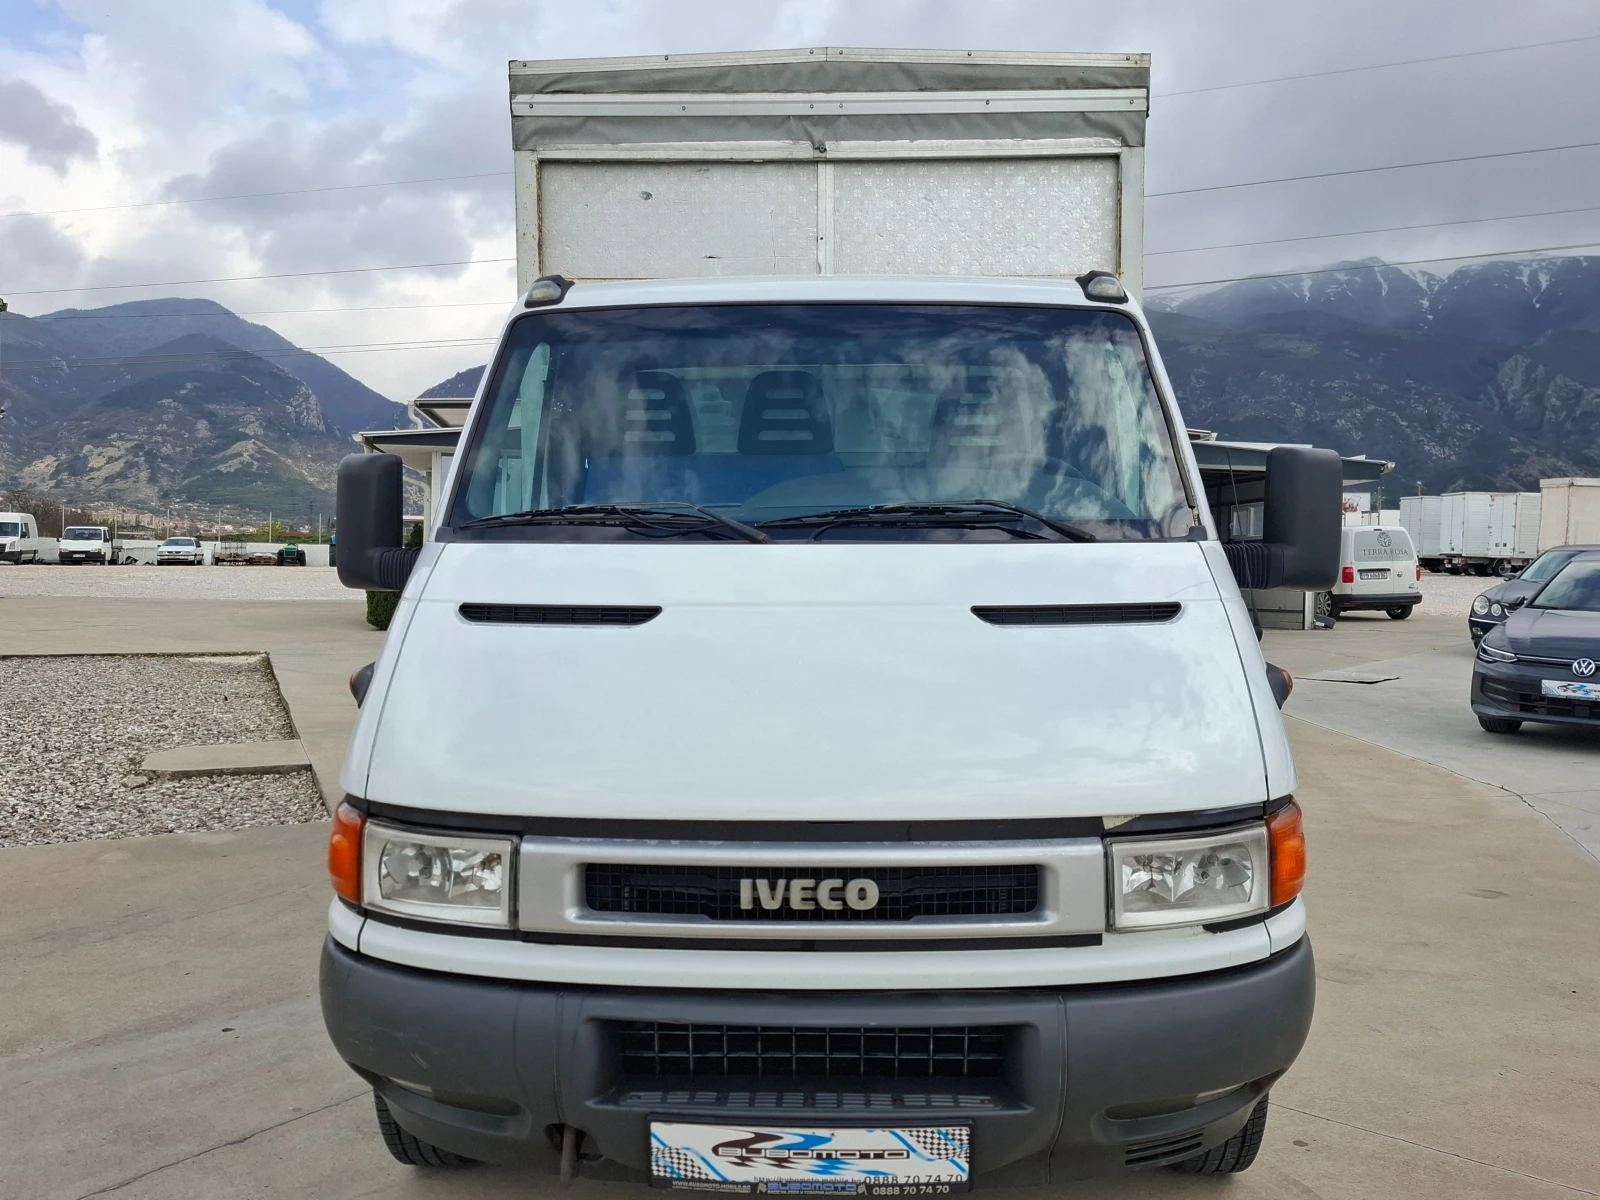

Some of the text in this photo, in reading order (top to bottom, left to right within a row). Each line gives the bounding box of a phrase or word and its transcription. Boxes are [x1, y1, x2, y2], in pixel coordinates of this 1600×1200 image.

[1363, 548, 1409, 556] TERRA ROSA
[740, 878, 880, 910] IVECO
[864, 1175, 899, 1184] 0888
[904, 1175, 920, 1183] 70
[925, 1174, 941, 1183] 74
[946, 1173, 963, 1182] 70
[872, 1185, 950, 1195] 0888 70 74 70
